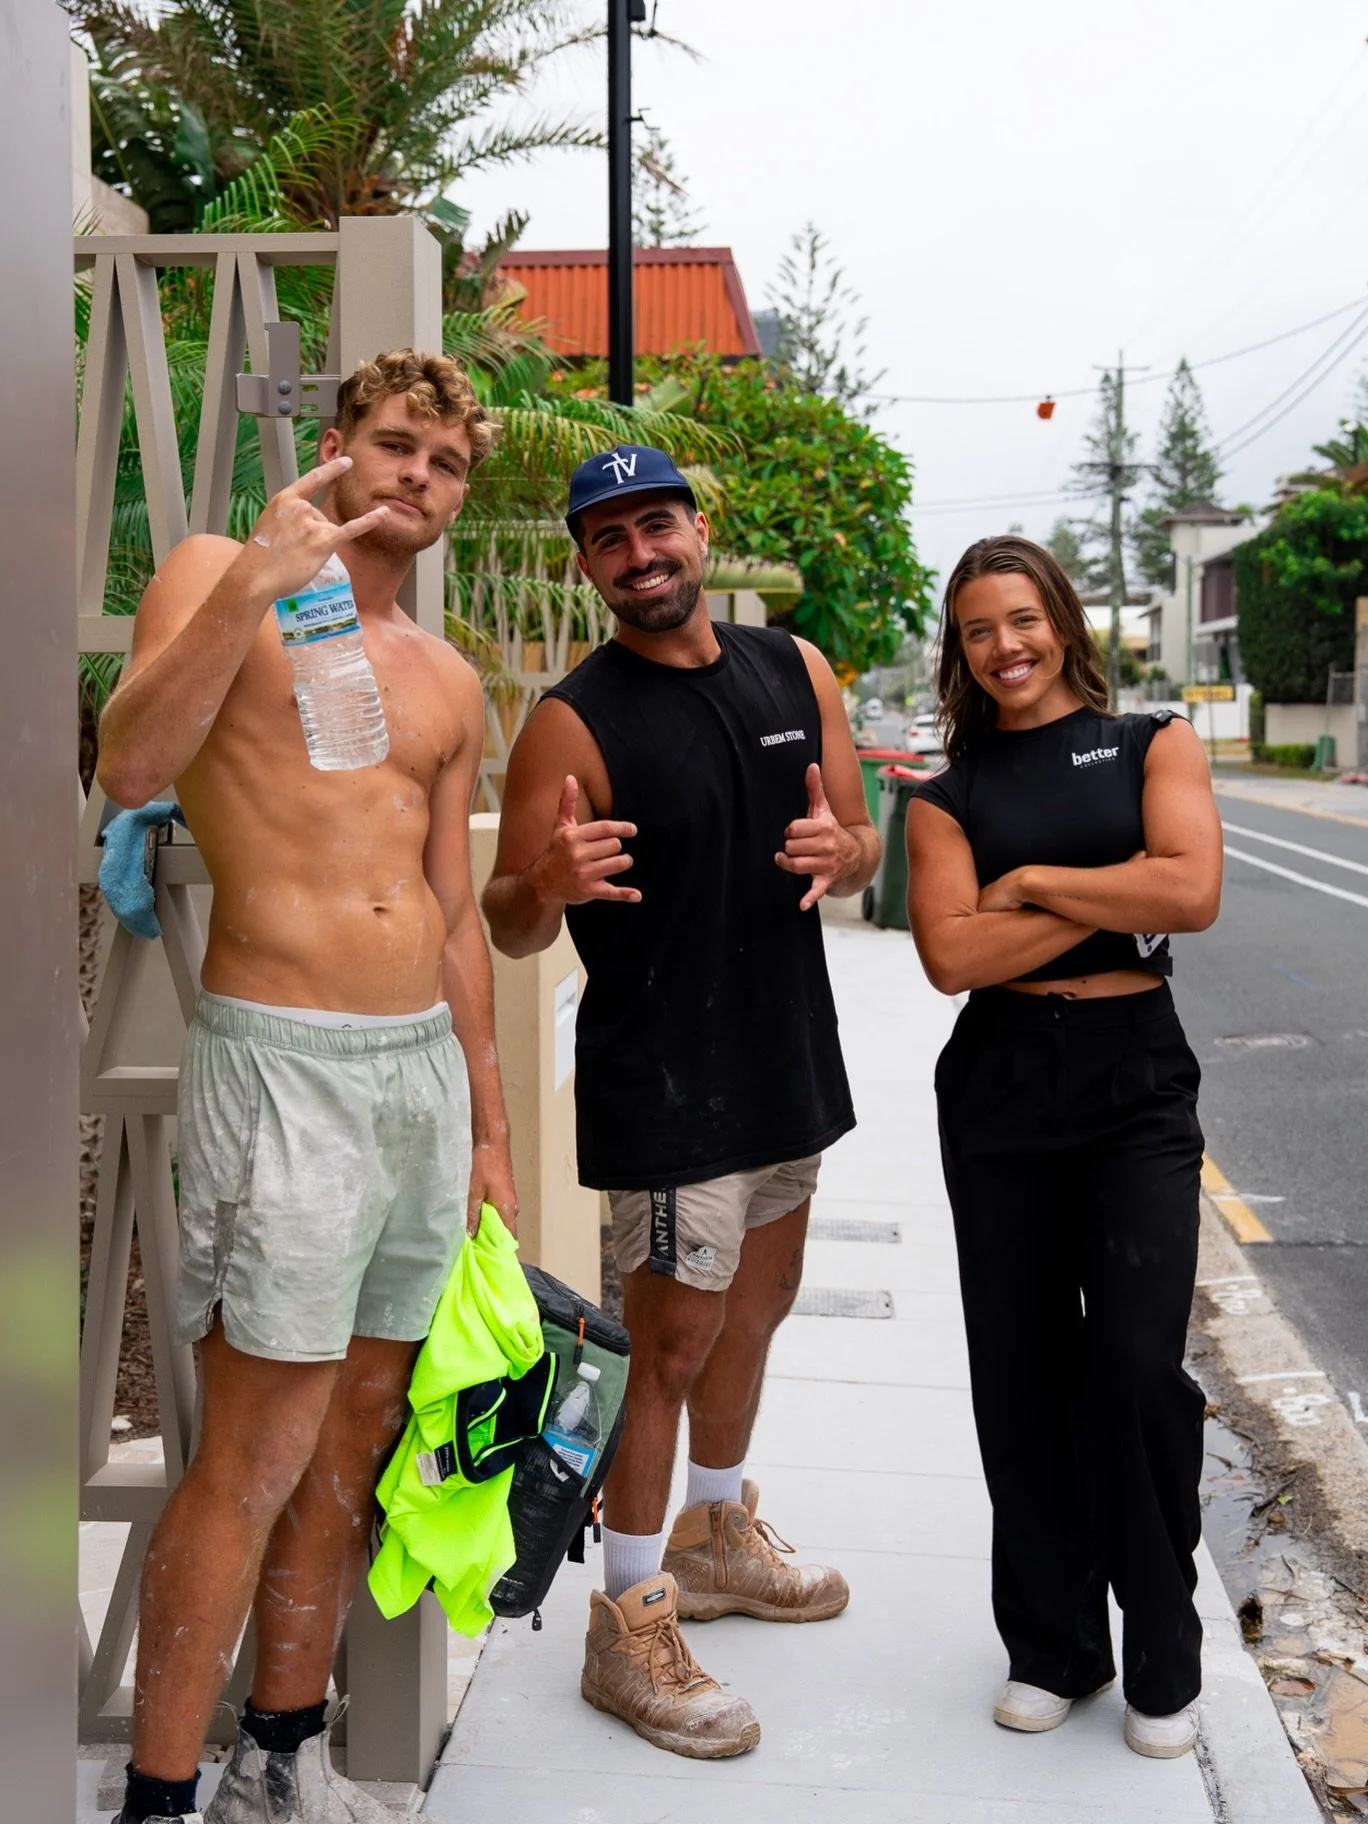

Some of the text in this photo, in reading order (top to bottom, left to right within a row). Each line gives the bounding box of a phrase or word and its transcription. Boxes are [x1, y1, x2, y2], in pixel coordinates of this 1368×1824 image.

[296, 604, 329, 622] SPRING
[329, 600, 354, 613] WATE
[785, 729, 806, 742] STONE
[1071, 746, 1119, 766] better
[653, 1187, 669, 1257] ANTHE
